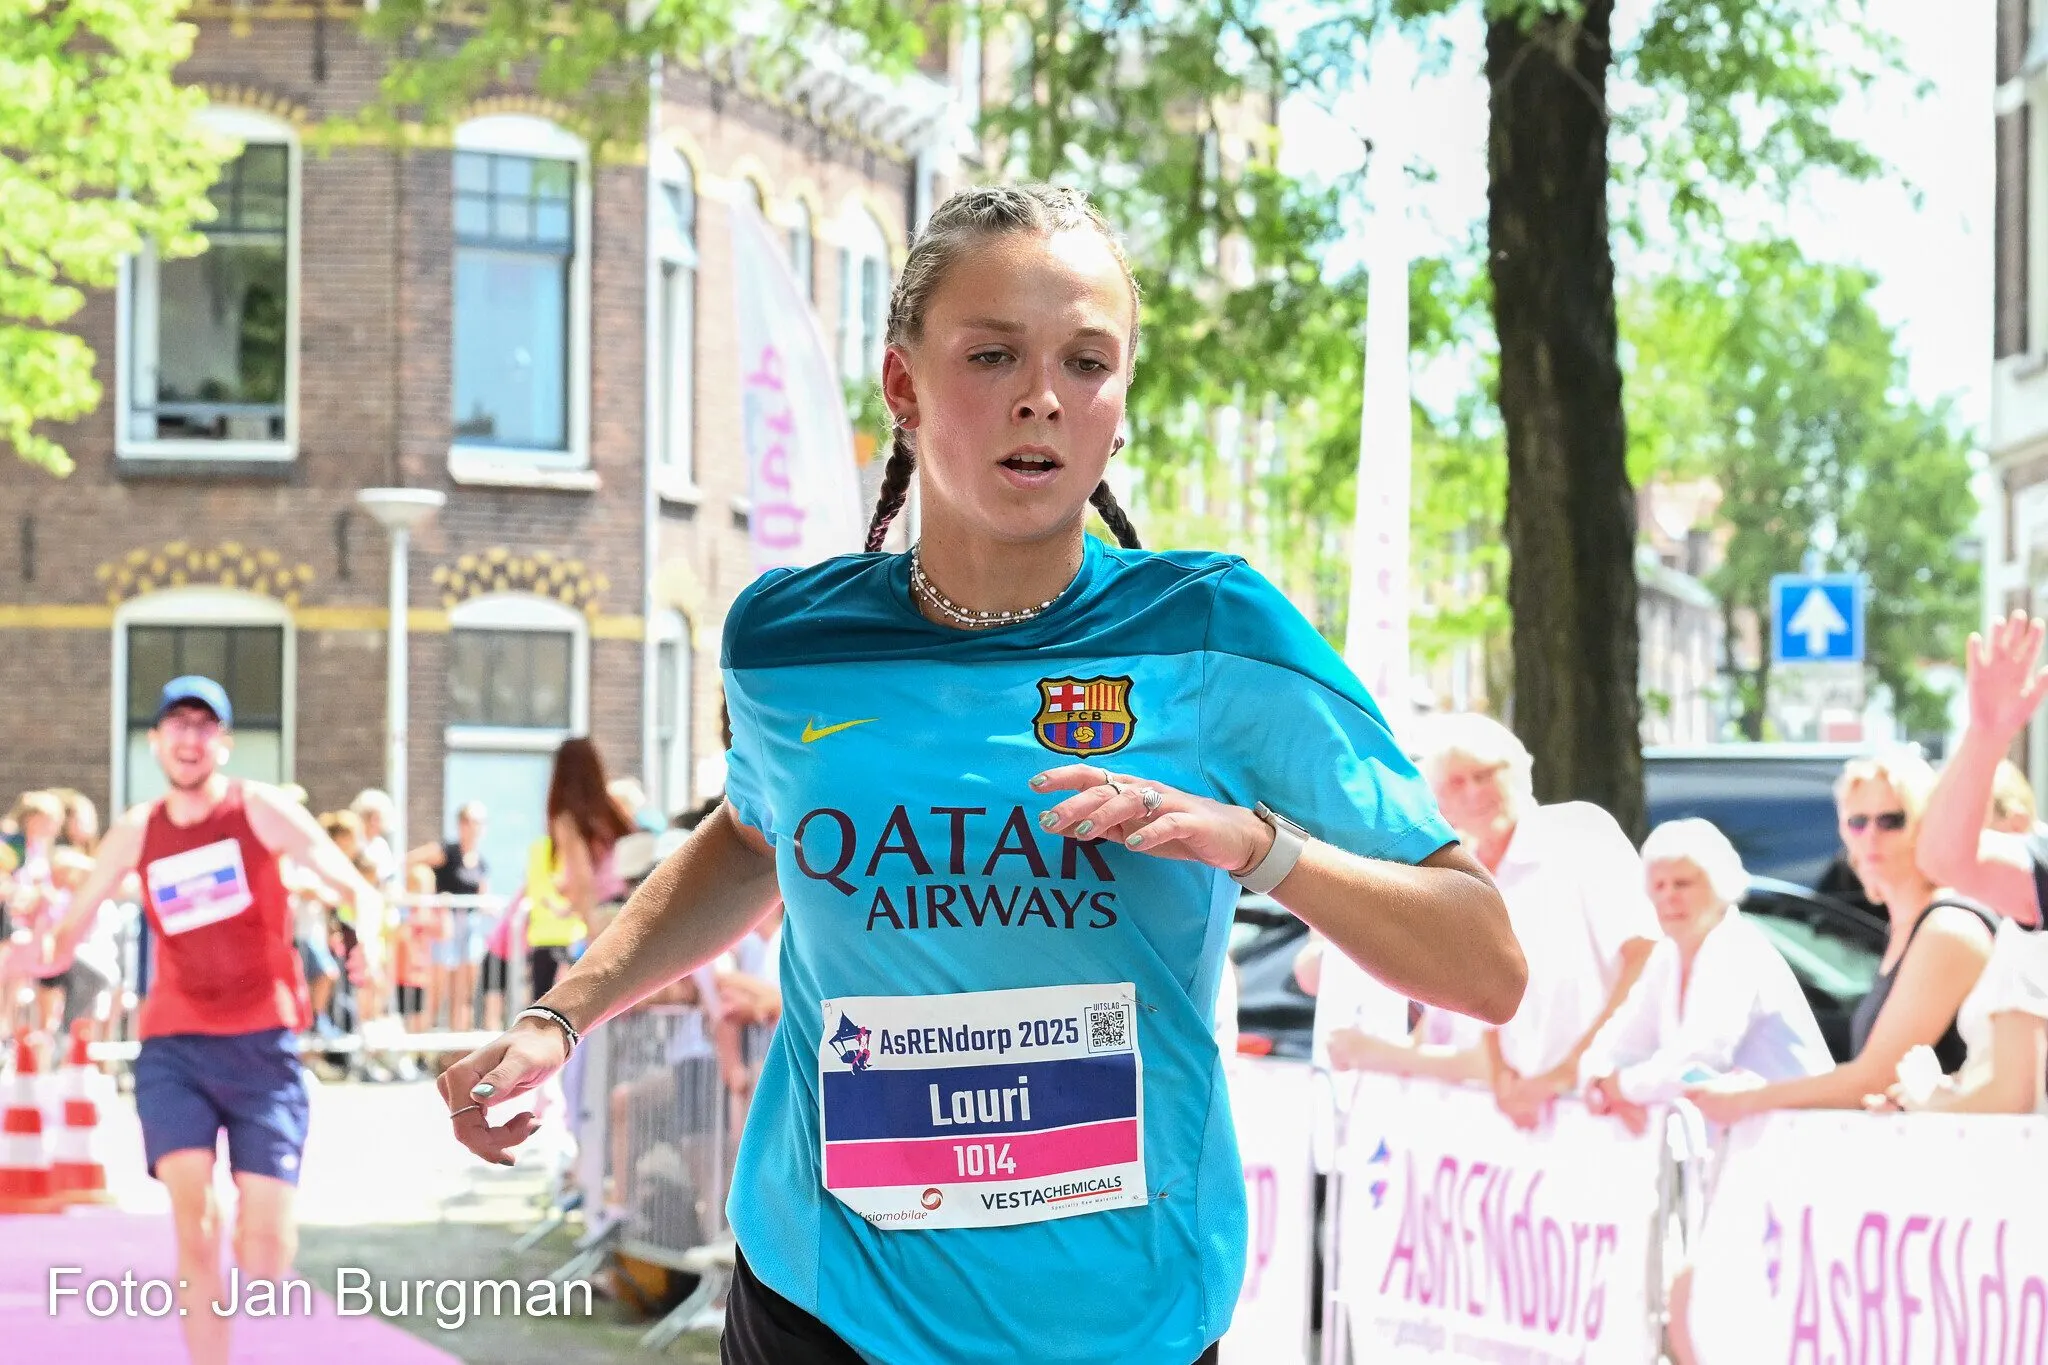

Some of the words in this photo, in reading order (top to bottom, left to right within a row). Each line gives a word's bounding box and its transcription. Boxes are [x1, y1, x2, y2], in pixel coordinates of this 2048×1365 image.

[1066, 711, 1102, 721] FCB
[794, 804, 1116, 897] QATAR
[866, 883, 1117, 931] AIRWAYS
[1093, 1002, 1120, 1011] UITSLAG
[879, 1023, 1012, 1056] AsRENdorp
[1018, 1017, 1079, 1048] 2025
[928, 1075, 1031, 1126] Lauri
[952, 1143, 1017, 1177] 1014
